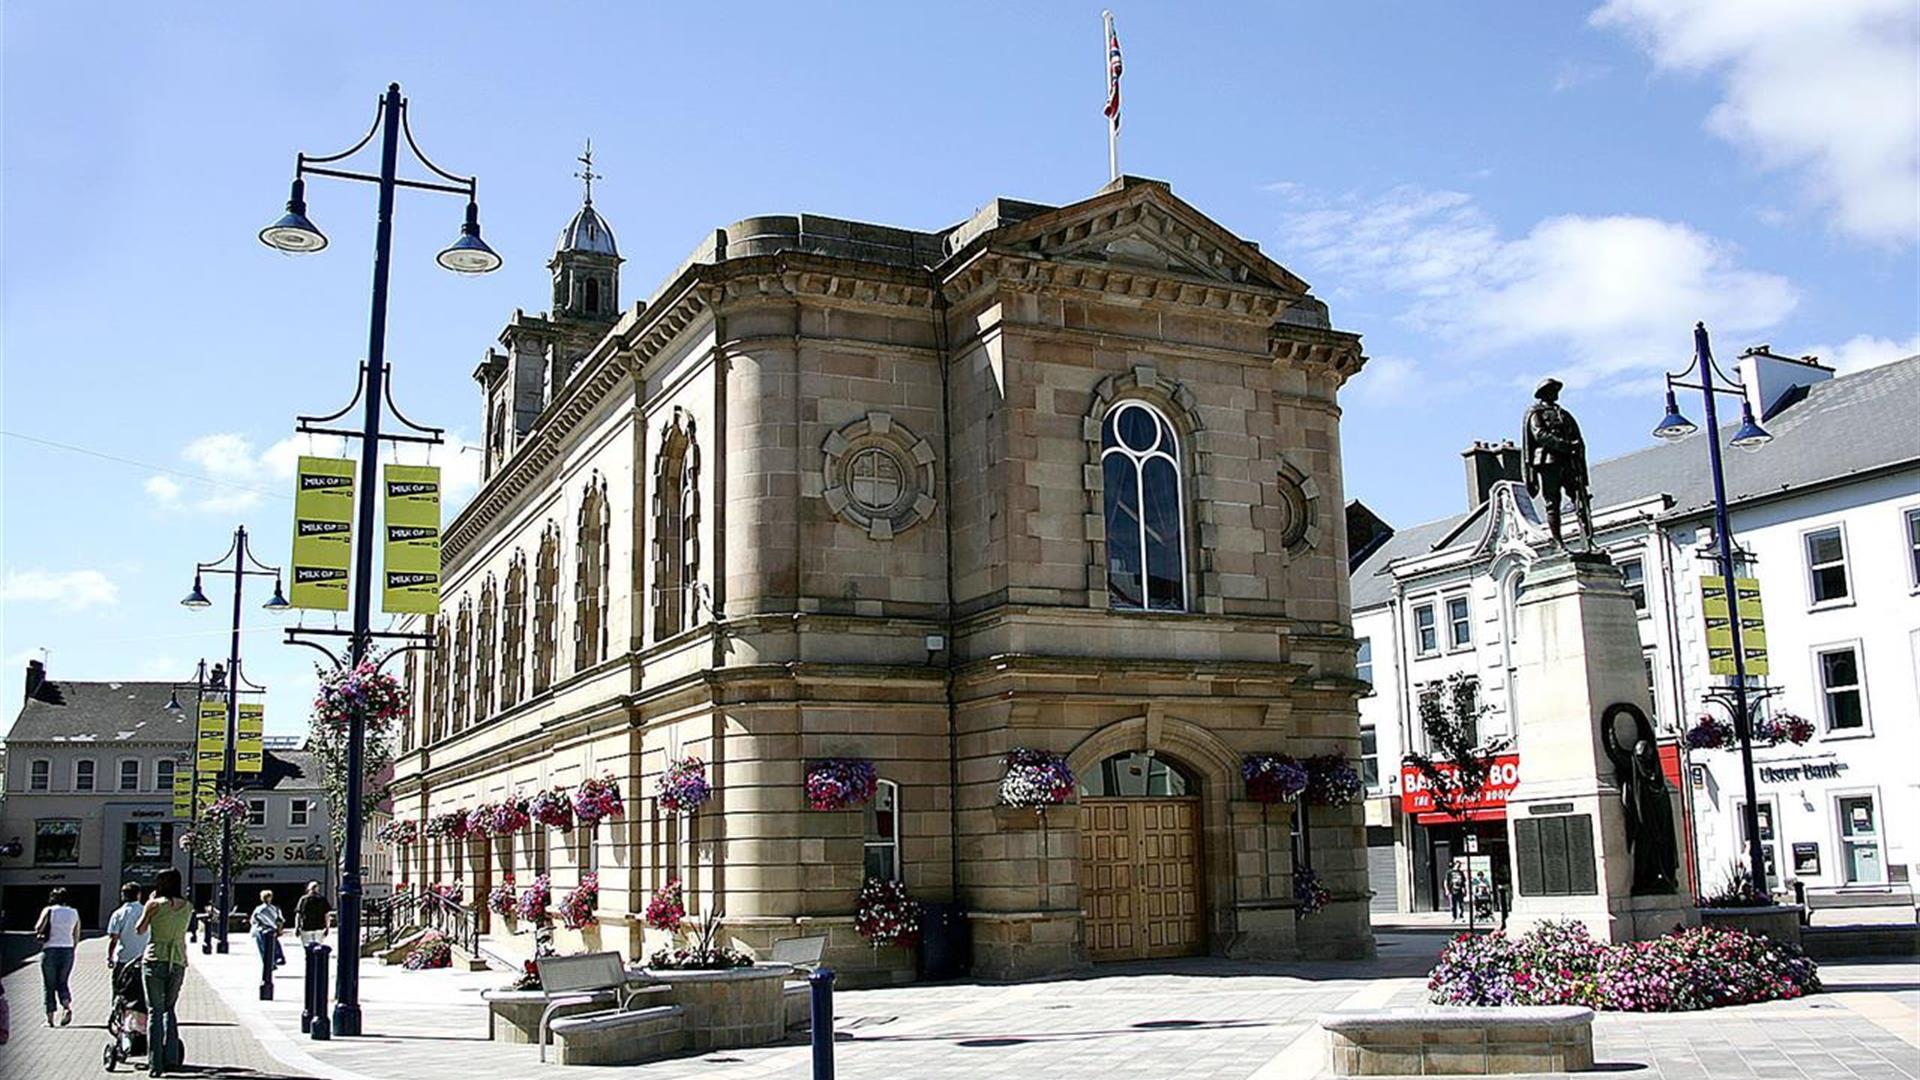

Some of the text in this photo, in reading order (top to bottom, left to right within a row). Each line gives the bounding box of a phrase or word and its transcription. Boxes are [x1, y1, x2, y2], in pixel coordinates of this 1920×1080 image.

[304, 477, 326, 486] MILK
[390, 484, 411, 493] MILK
[301, 523, 323, 532] MILK
[391, 529, 411, 538] MILK
[299, 570, 321, 579] MILK
[390, 575, 411, 584] MILK
[1759, 762, 1842, 784] Ulster Bank
